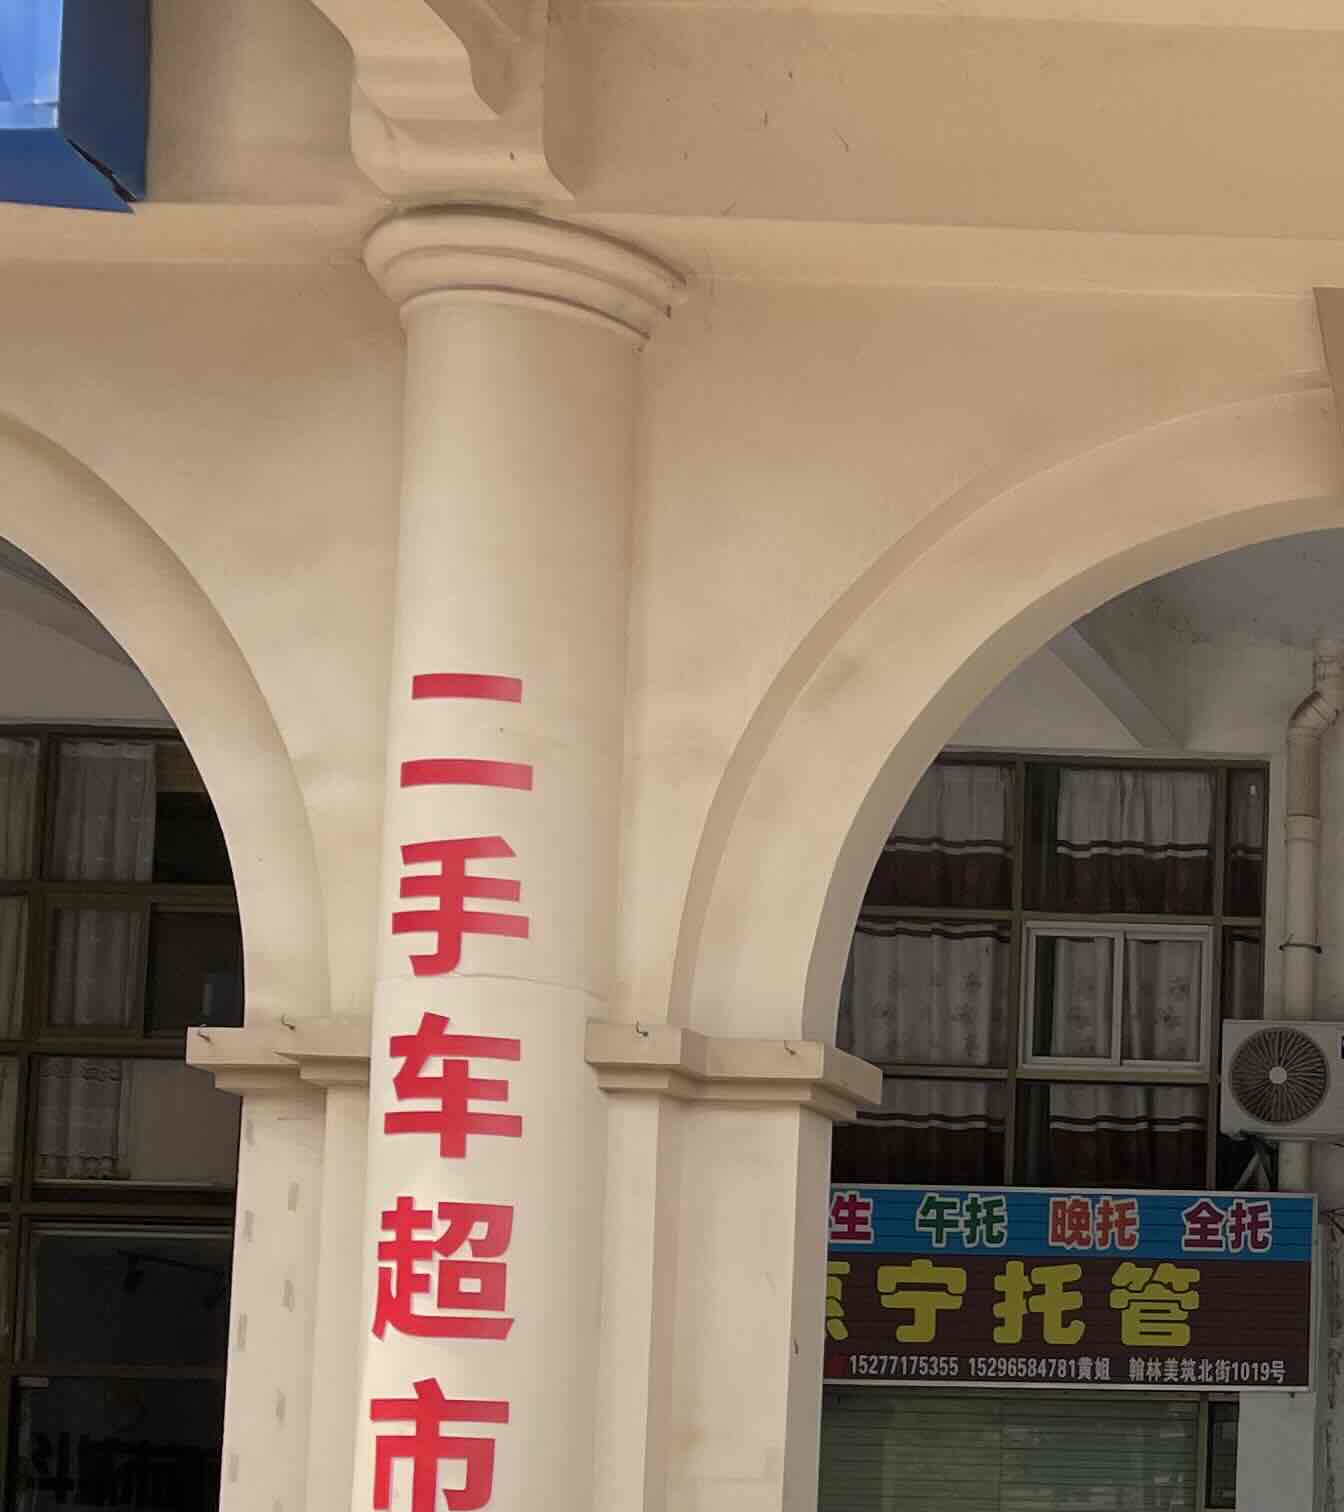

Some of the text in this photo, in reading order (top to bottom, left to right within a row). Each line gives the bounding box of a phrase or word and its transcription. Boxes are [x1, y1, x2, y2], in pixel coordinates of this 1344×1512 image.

[831, 1191, 1272, 1253] 生 午托 晚托 全托
[826, 1259, 1201, 1347] 宁托管
[848, 1354, 960, 1377] 15277175355
[1128, 1357, 1287, 1384] 翰林美筑北街1019号
